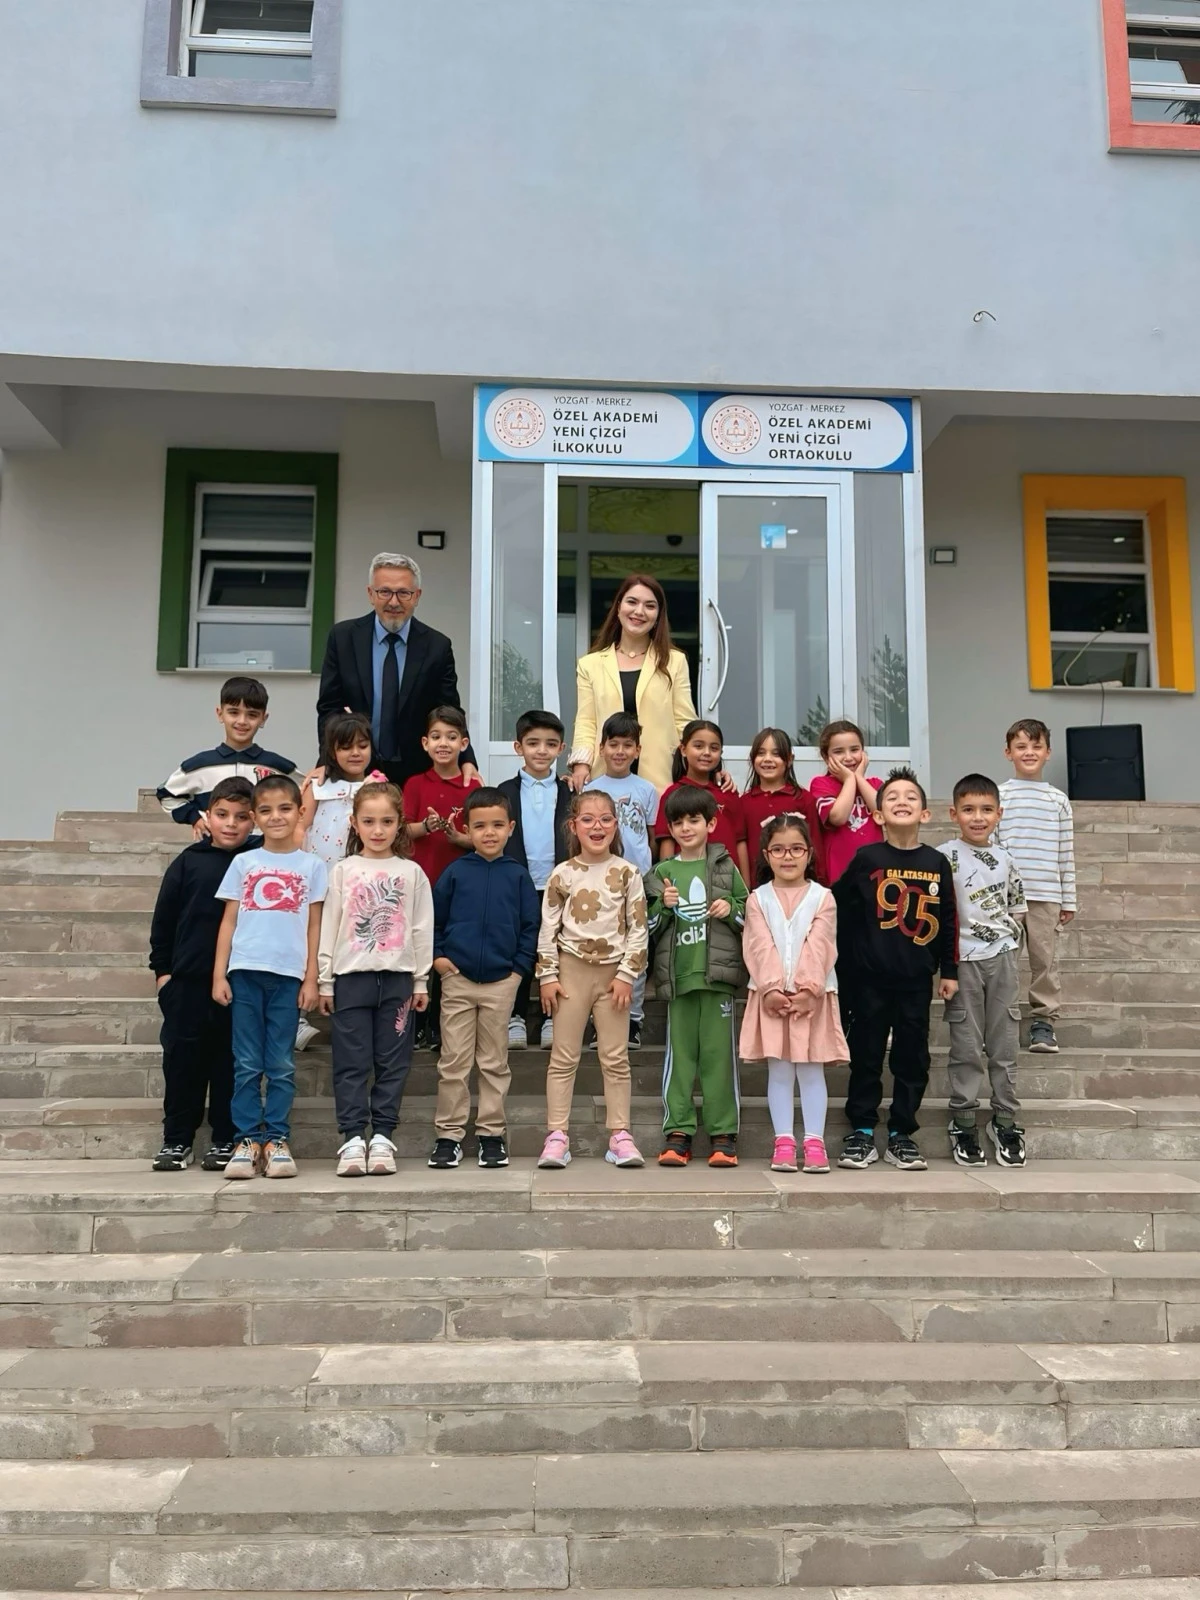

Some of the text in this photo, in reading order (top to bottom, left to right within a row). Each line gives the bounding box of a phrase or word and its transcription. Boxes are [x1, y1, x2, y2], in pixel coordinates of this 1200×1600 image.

[554, 396, 588, 405] YOZGAT
[596, 397, 632, 406] MERKEZ
[769, 403, 803, 412] YOZGAT
[810, 404, 846, 413] MERKEZ
[553, 410, 658, 423] ÖZEL AKADEMİ
[769, 415, 871, 430] ÖZEL AKADEMİ
[553, 424, 626, 440] YENİ ÇİZGİ
[769, 431, 841, 446] YENİ ÇİZGİ
[553, 440, 622, 454] İLKOKULU
[769, 449, 852, 461] ORTAOKULU
[868, 868, 940, 946] 1905
